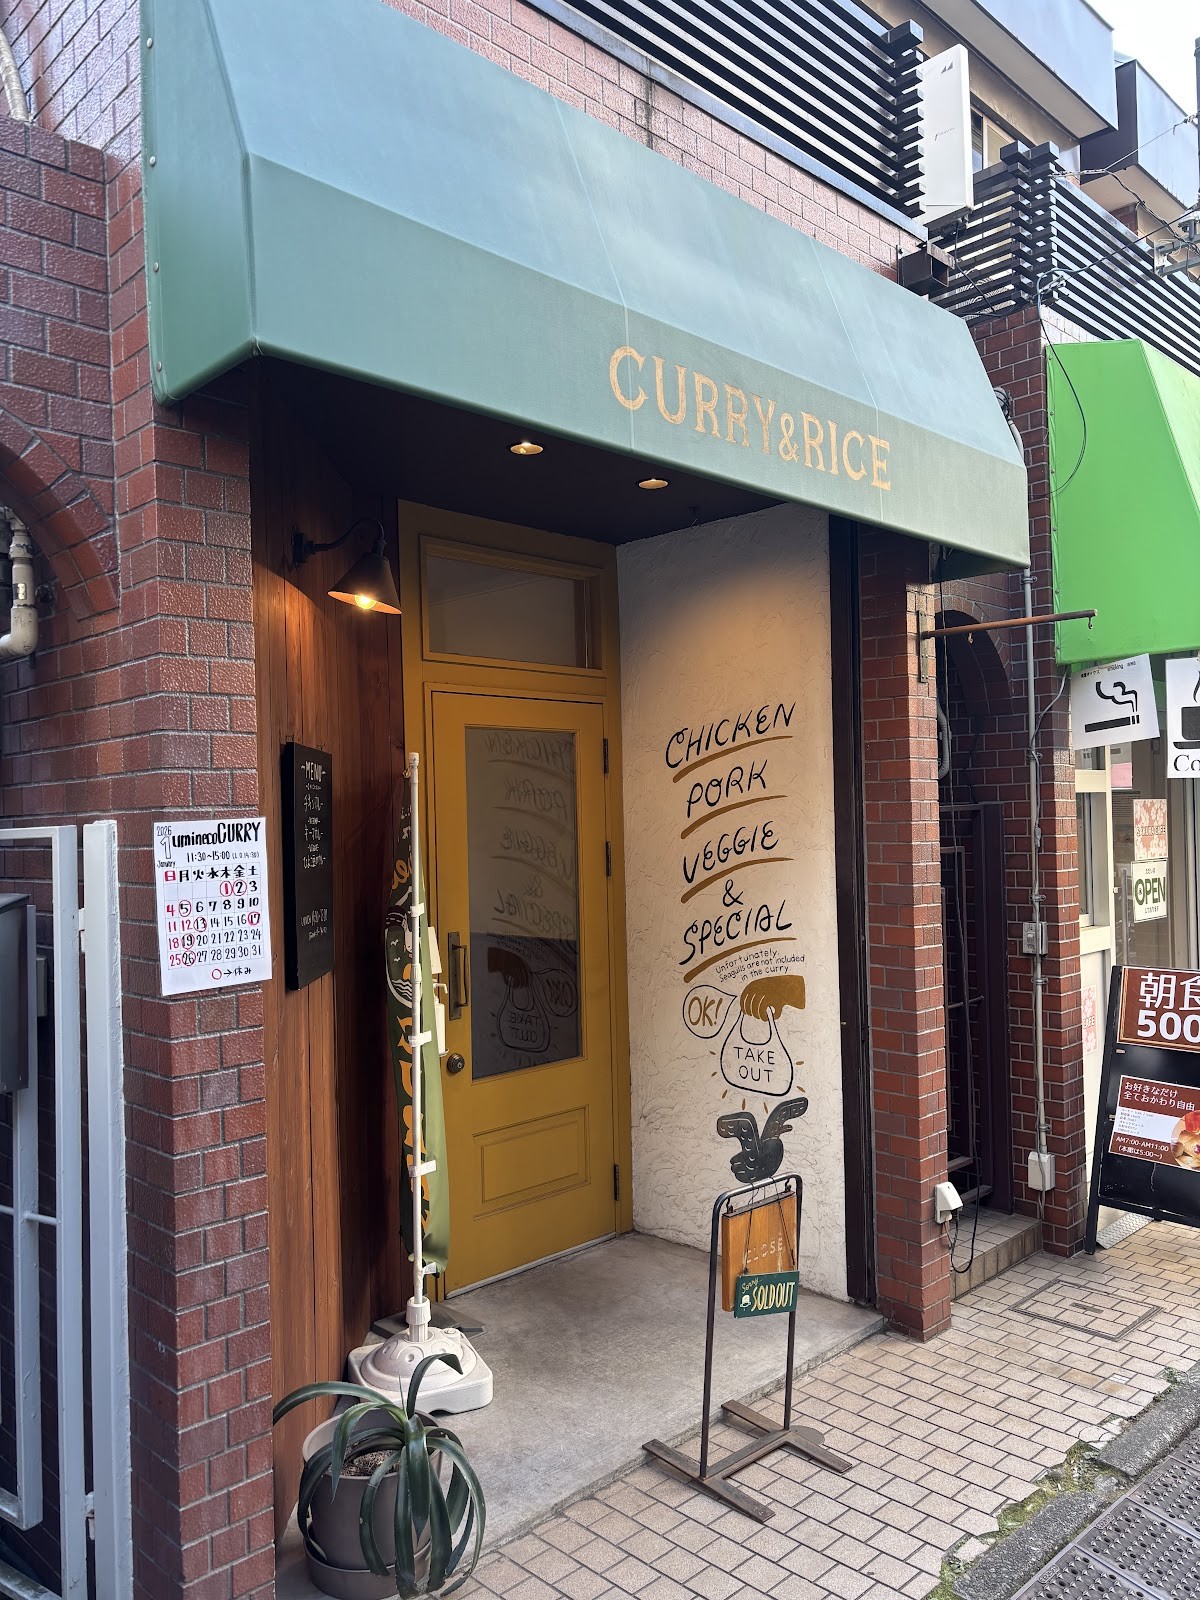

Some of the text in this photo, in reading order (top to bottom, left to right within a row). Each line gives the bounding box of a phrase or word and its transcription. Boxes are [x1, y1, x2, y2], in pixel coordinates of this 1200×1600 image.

[665, 701, 796, 769] CHICKEN
[686, 759, 768, 819] PORK
[157, 825, 172, 837] 2026
[683, 820, 779, 884] VEGGIE
[165, 864, 259, 882] 日 月 火 水 木 金 土
[224, 880, 258, 895] 1 2 3
[722, 879, 744, 908] &
[1134, 876, 1166, 906] OPEN
[166, 897, 259, 917] 4 5 6 7 8 9 10
[168, 914, 260, 932] 11 12 13 14 15 16 17
[678, 899, 793, 966] SPECIAL
[168, 928, 261, 950] 18 19 20 21 22 23 24
[170, 944, 261, 966] 25 26 27 28 29 30 31
[775, 953, 805, 964] included
[234, 966, 252, 975] 休み
[750, 967, 763, 978] the
[688, 996, 723, 1027] OK!
[1137, 1009, 1200, 1043] 500
[733, 1046, 775, 1065] TAKE
[738, 1065, 774, 1082] OUT
[1125, 1082, 1178, 1098] お好きなだけ
[1123, 1091, 1195, 1111] 全ておかわり自由
[1115, 1136, 1169, 1152] AM7:00-AM11:00
